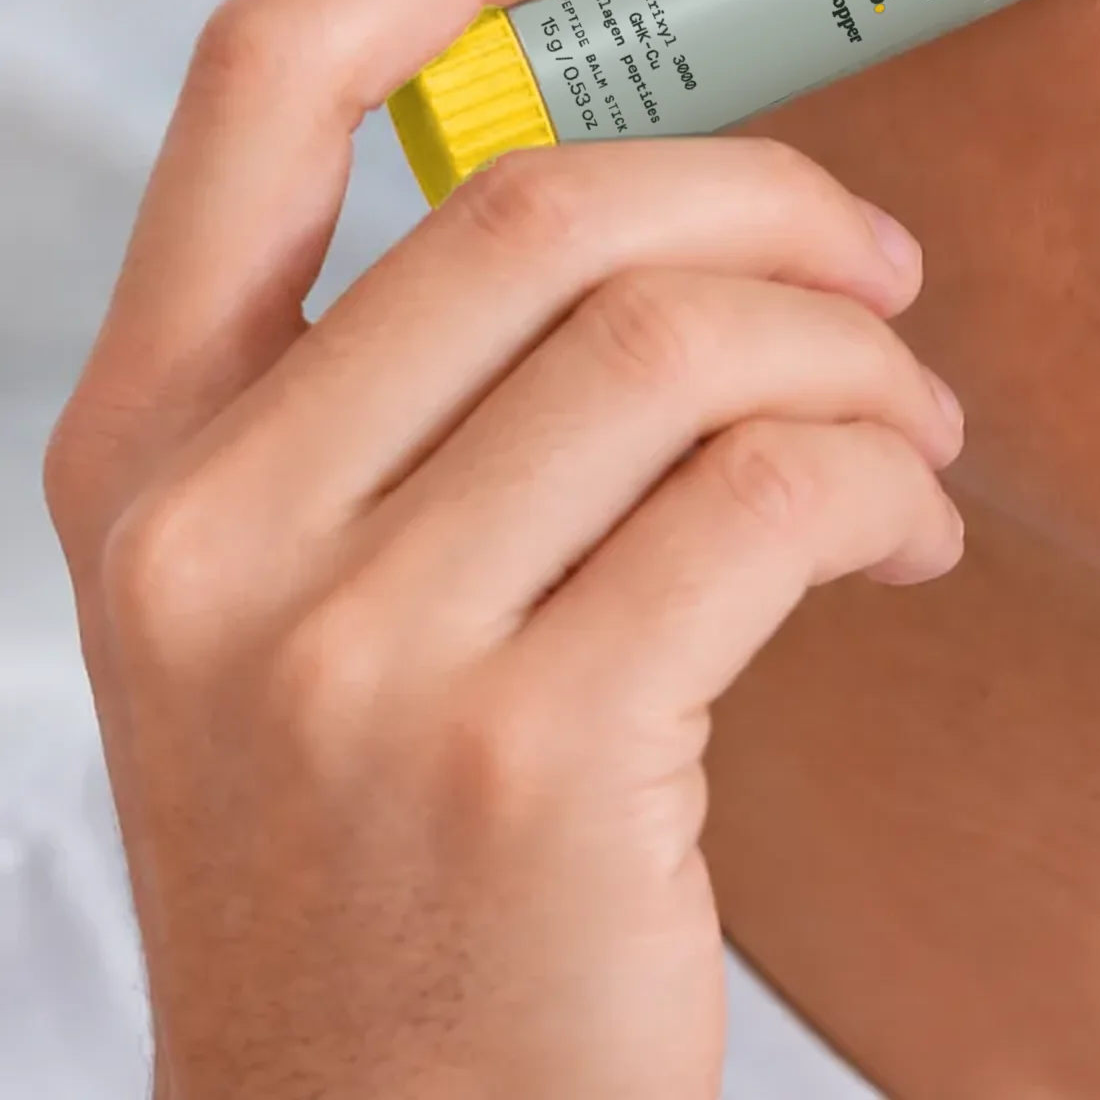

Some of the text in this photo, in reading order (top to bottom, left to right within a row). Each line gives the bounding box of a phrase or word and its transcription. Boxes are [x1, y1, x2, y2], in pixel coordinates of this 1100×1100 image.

[541, 16, 560, 36] 15
[629, 12, 661, 70] GHK-Cu
[546, 39, 563, 53] g
[563, 66, 591, 107] 0.53
[620, 54, 660, 124] peptides
[673, 54, 697, 90] 3000
[585, 53, 608, 89] BALM
[604, 94, 628, 133] STICK
[582, 109, 599, 131] oz
